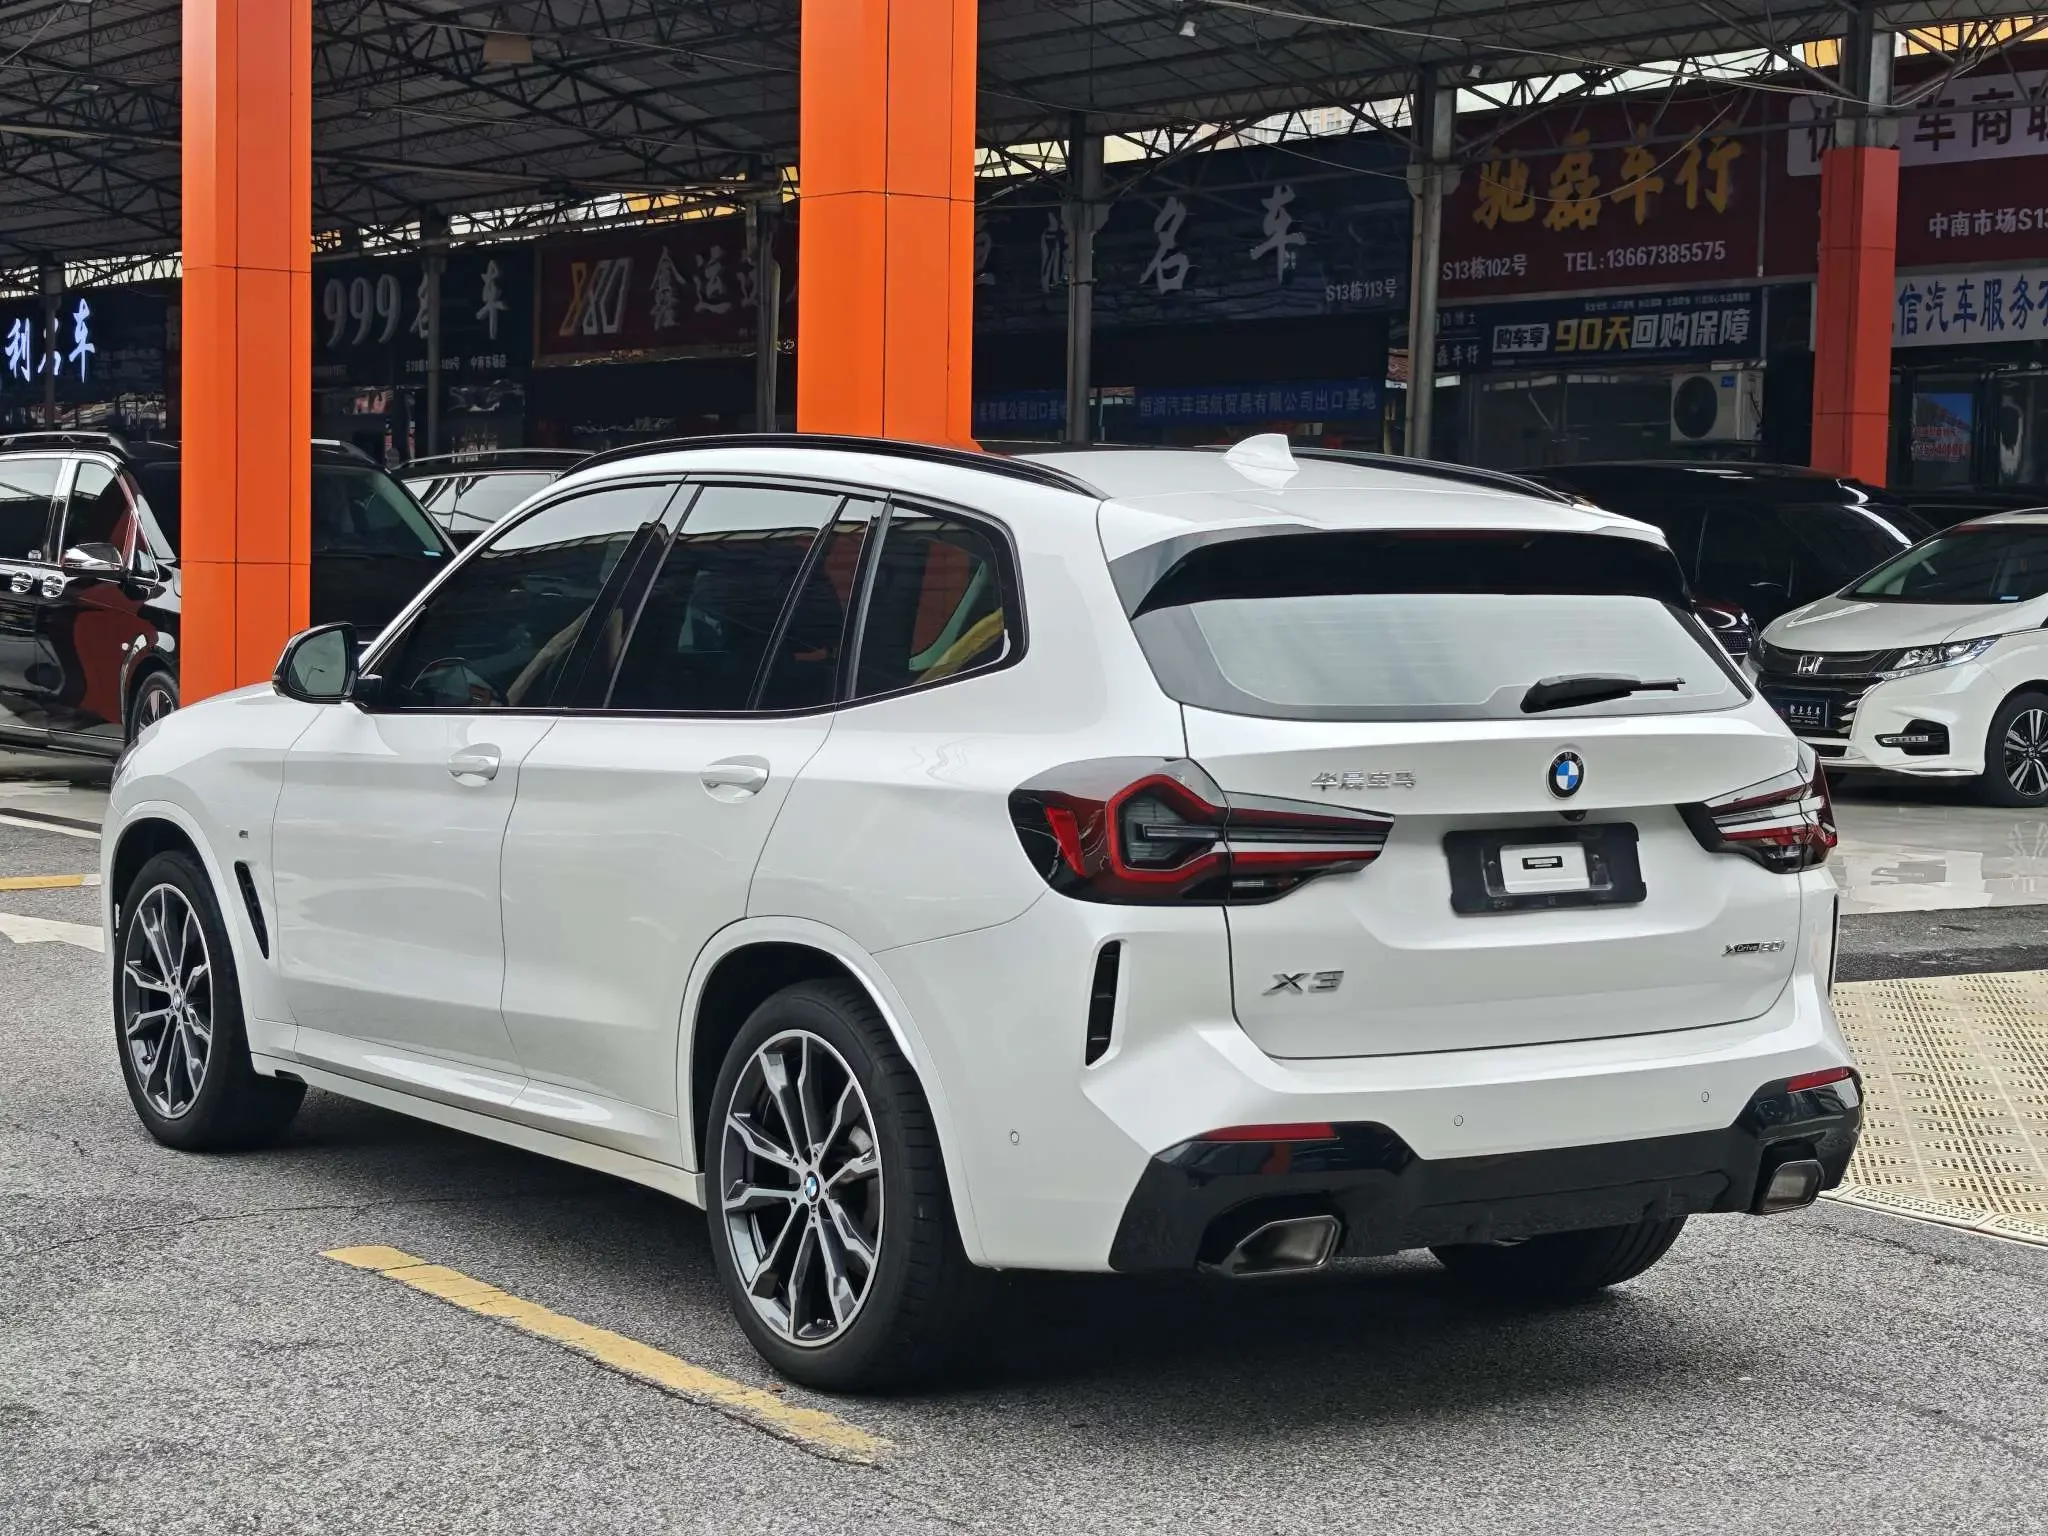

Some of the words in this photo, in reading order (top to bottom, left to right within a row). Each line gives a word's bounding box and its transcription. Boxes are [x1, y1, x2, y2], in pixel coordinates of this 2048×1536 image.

[1472, 121, 1743, 232] 驰磊车行
[1443, 254, 1527, 280] S13栋102号
[1564, 240, 1726, 273] TEL:13667385575
[1554, 308, 1751, 352] 90天回购保障
[1311, 769, 1416, 791] 华晨宝马
[1261, 970, 1344, 996] X3
